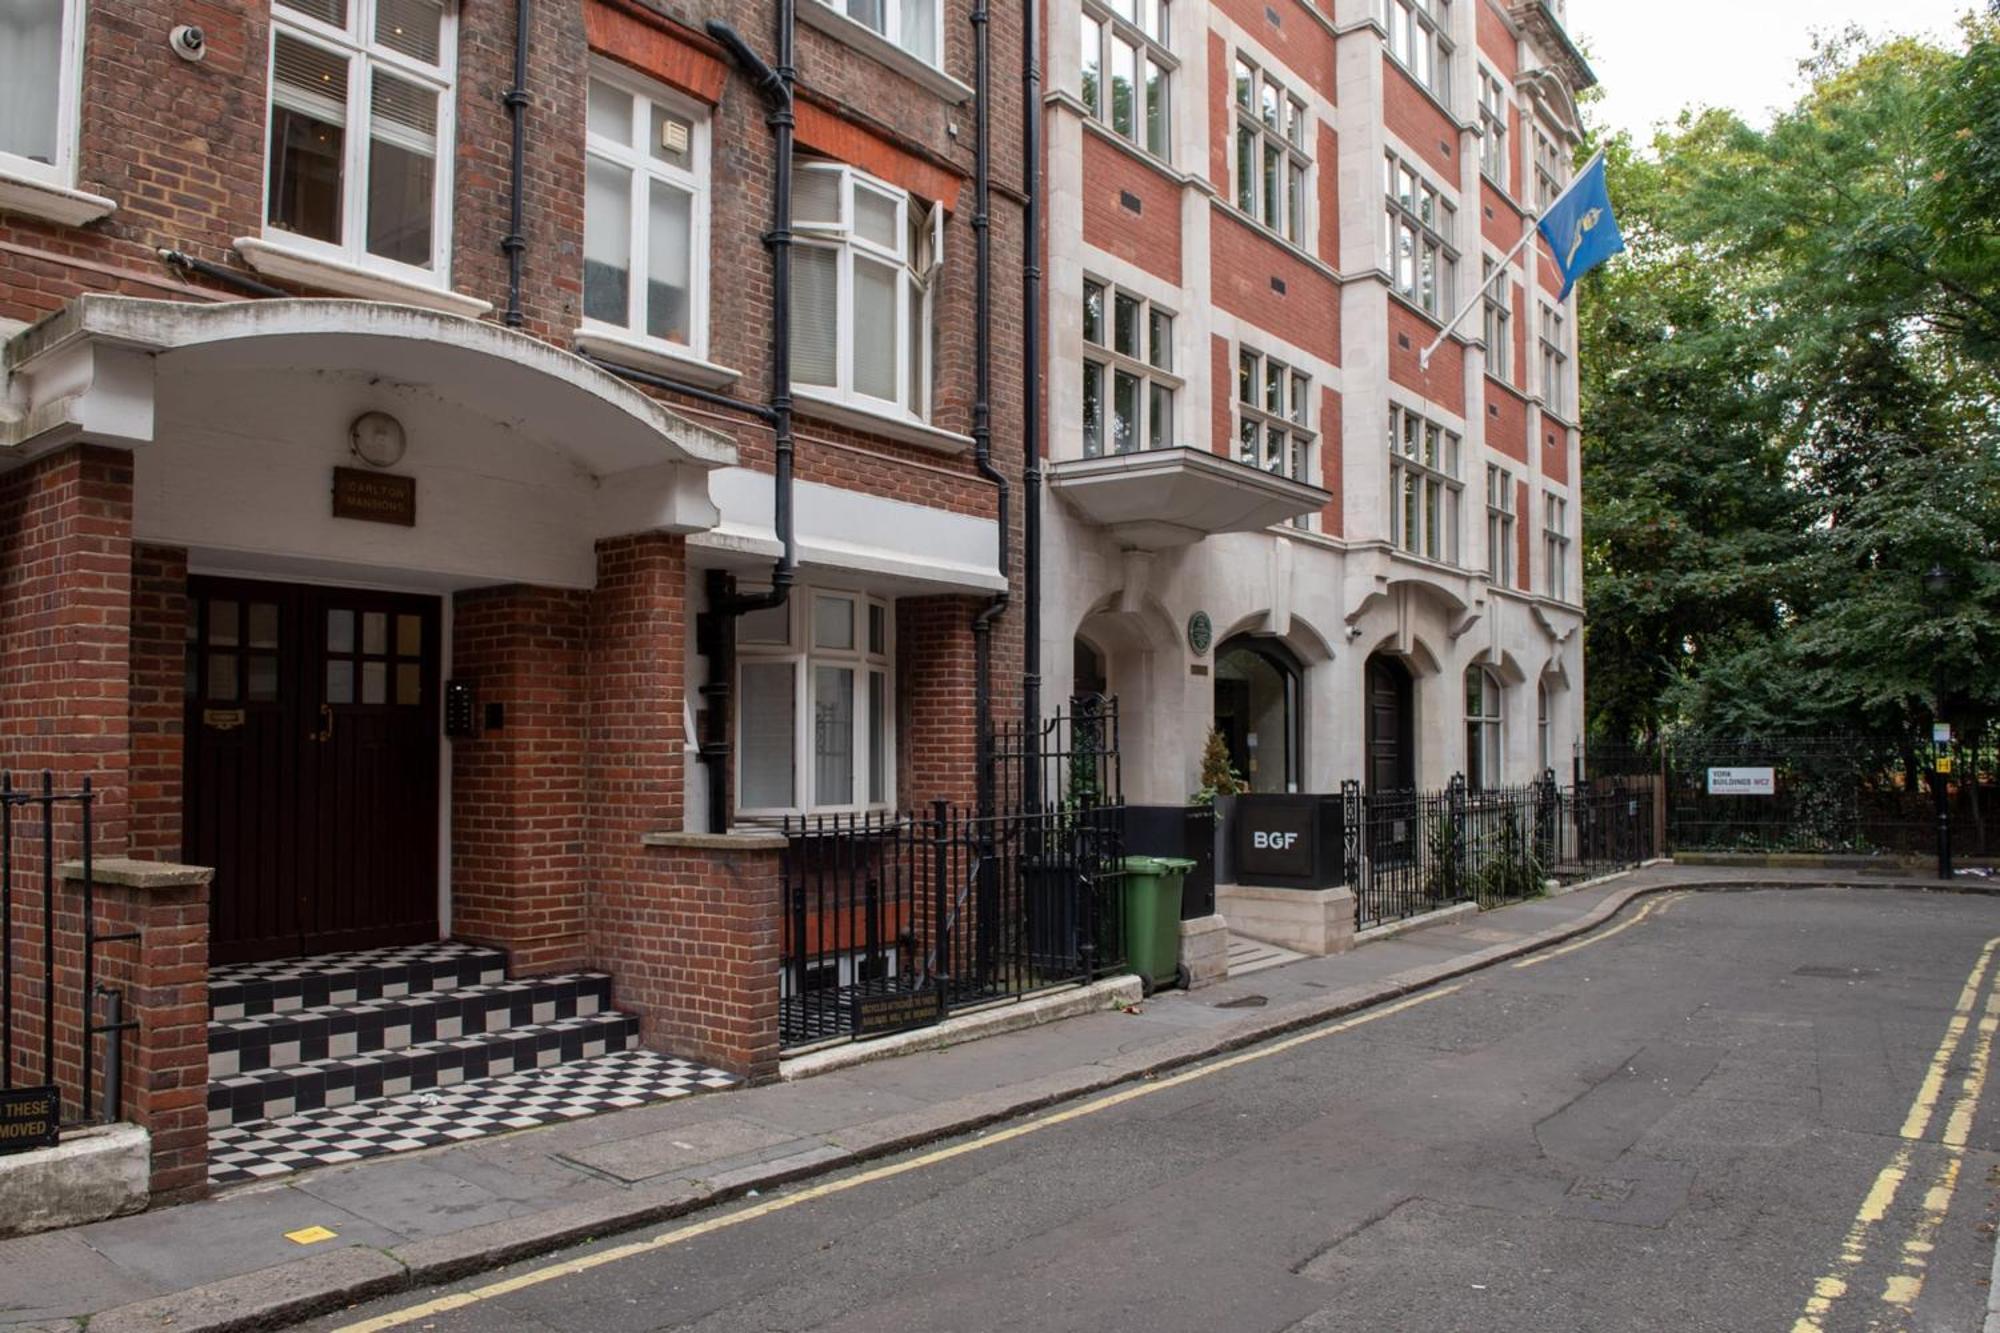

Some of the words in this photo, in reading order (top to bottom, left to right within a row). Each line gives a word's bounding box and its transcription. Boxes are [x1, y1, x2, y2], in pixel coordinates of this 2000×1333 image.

[1254, 831, 1298, 849] BGF
[5, 1100, 49, 1118] THESE
[0, 1120, 47, 1139] MOVED
